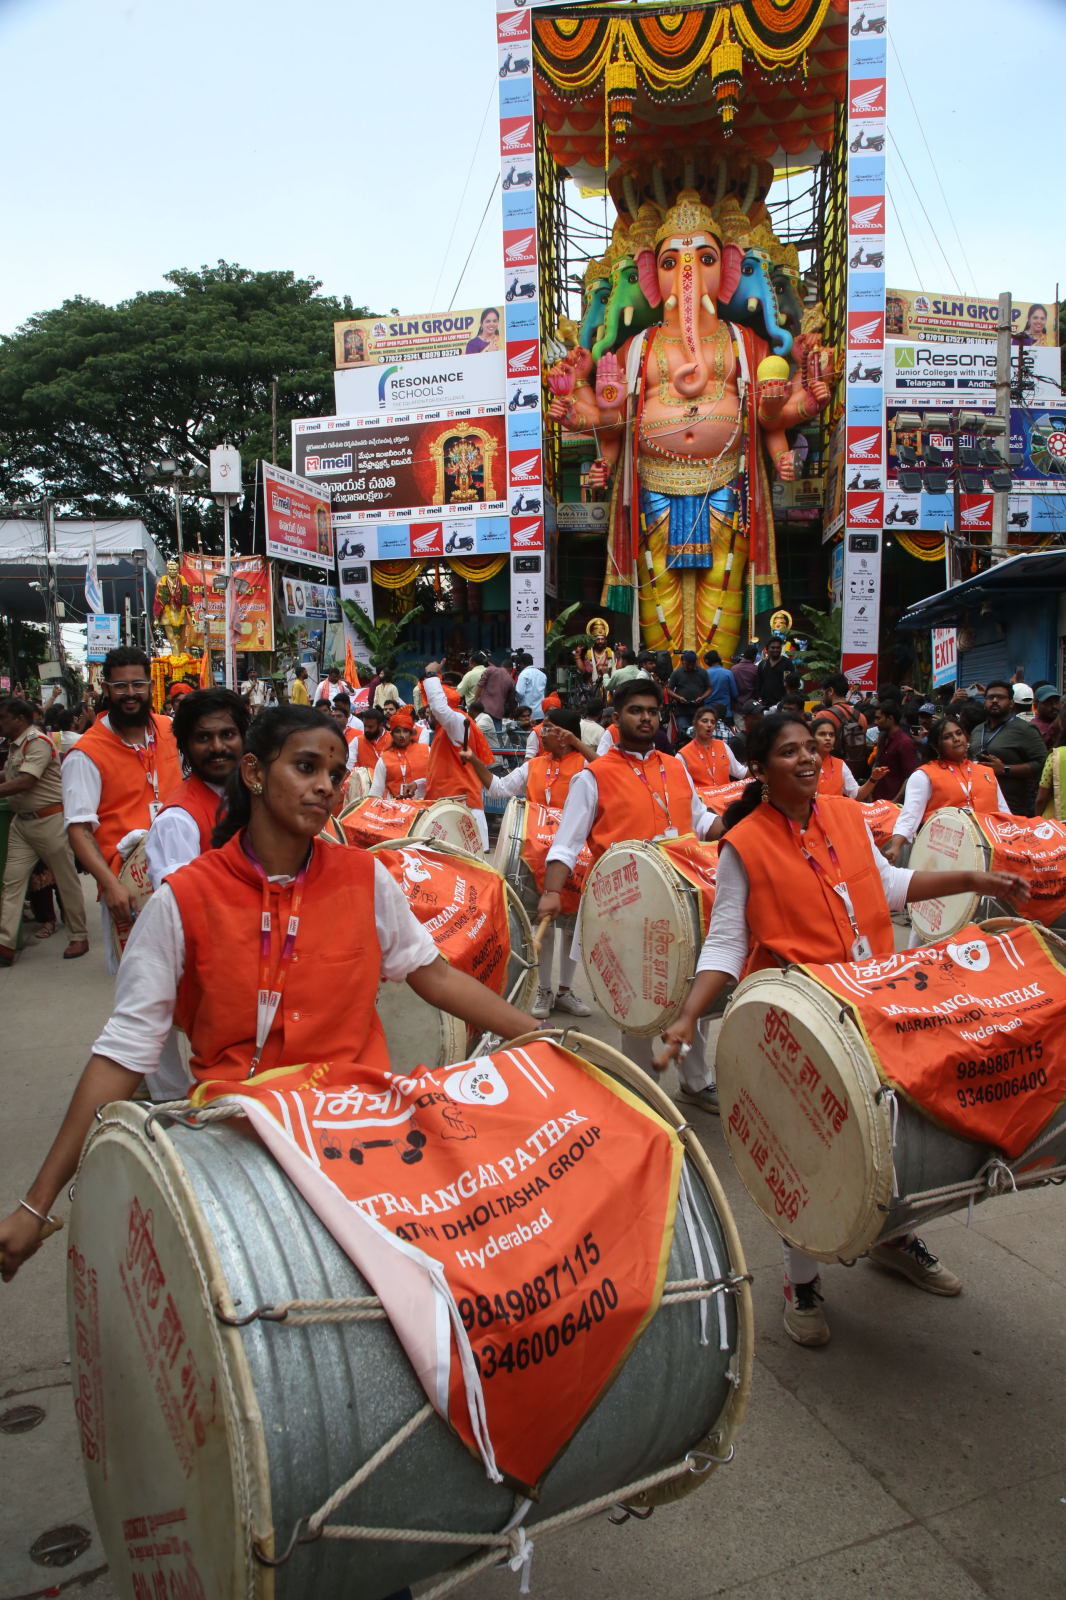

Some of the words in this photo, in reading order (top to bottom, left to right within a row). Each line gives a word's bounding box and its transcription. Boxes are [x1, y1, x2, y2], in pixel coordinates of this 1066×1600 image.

[500, 30, 528, 38] HONDA
[503, 142, 532, 150] HONDA
[506, 254, 535, 262] HONDA
[932, 300, 964, 316] SLN
[967, 304, 1021, 322] GROP
[390, 320, 419, 336] SLN
[422, 316, 474, 334] GROUP
[390, 372, 464, 389] RESONANCE
[924, 369, 957, 377] Colleges
[392, 386, 444, 400] SCHOOLS
[323, 454, 352, 469] meil
[368, 476, 396, 490] చవితి
[934, 636, 954, 670] EXIT
[982, 982, 1046, 1009] PATHAK
[895, 1014, 952, 1034] MARATHI
[956, 1040, 1044, 1080] 9849887115
[956, 1068, 1048, 1108] 9346006400
[499, 1109, 589, 1179] PATHAK
[548, 1126, 601, 1180] GROUP
[455, 1208, 553, 1269] Hyderabad
[458, 1232, 600, 1332] 9849887115
